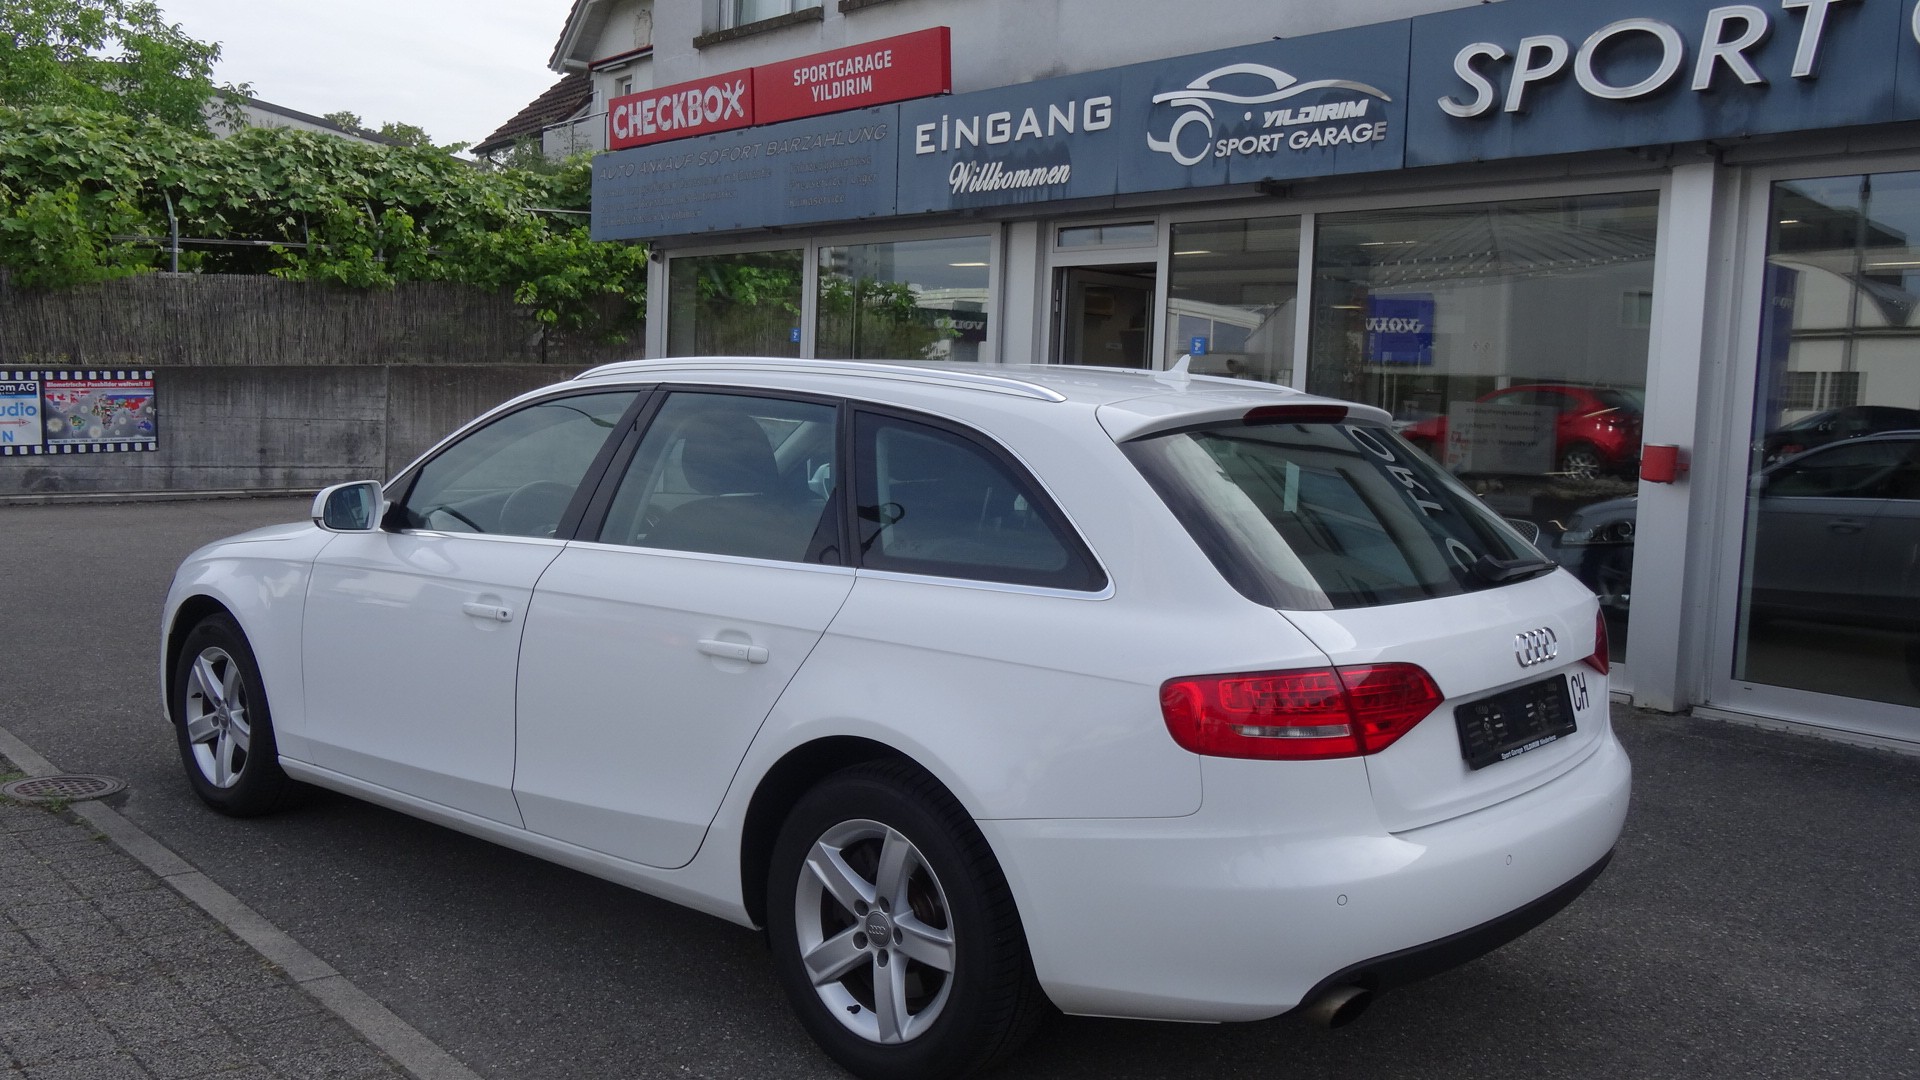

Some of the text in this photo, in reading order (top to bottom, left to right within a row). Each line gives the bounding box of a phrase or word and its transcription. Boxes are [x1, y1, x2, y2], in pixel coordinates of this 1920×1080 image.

[793, 49, 893, 87] SPORTGARAGE
[1437, 0, 1850, 118] SPORT
[811, 75, 873, 103] YILDIRIM
[612, 79, 745, 140] CHECKBOX
[1262, 99, 1369, 129] YILDIRIM
[599, 123, 888, 180] AUTO ANKAUF SOFORT BARZAHLUNG
[1214, 121, 1388, 159] SPORT GARAGE
[949, 160, 1071, 195] Willkommen
[18, 383, 36, 392] AG
[1570, 672, 1590, 712] CH
